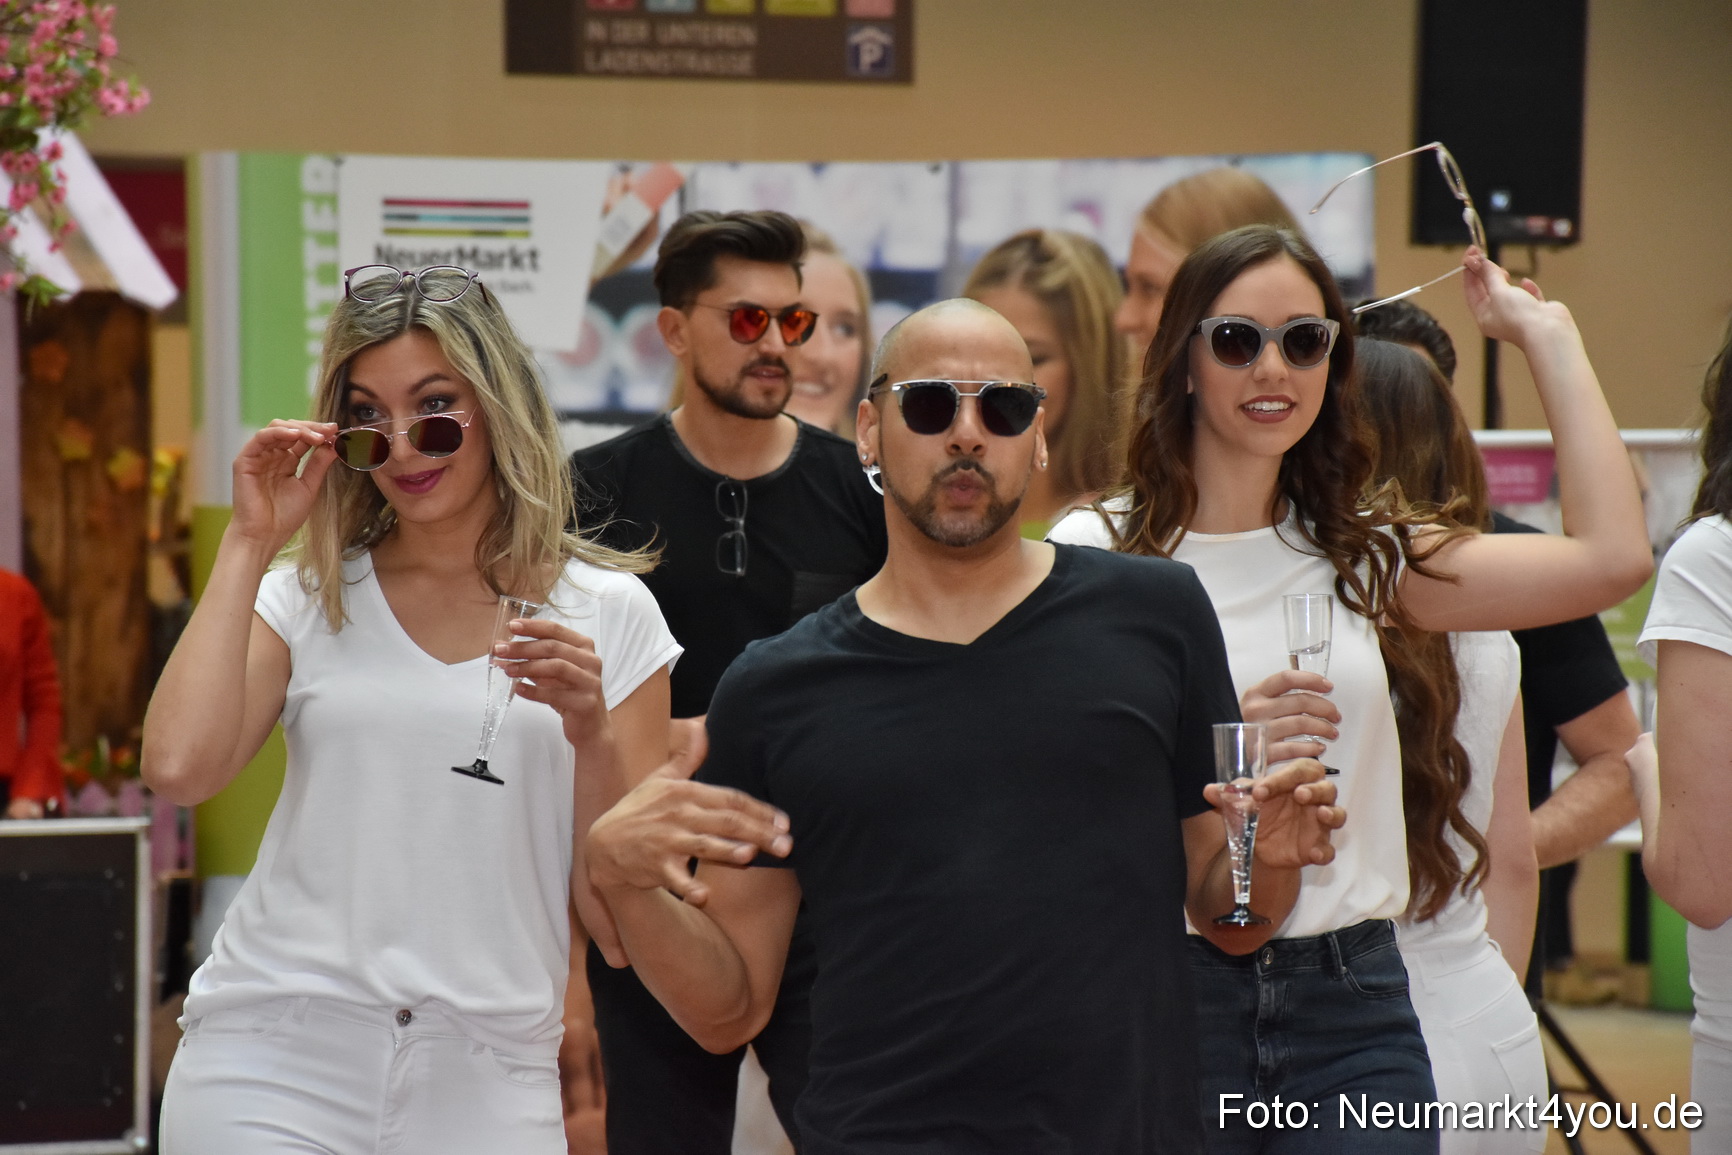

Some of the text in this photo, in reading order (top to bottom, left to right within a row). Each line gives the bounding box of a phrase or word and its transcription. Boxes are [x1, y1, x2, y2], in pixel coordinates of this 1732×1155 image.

[585, 21, 757, 46] IN DER UNTEREN
[585, 49, 755, 73] LADENSTRASSE
